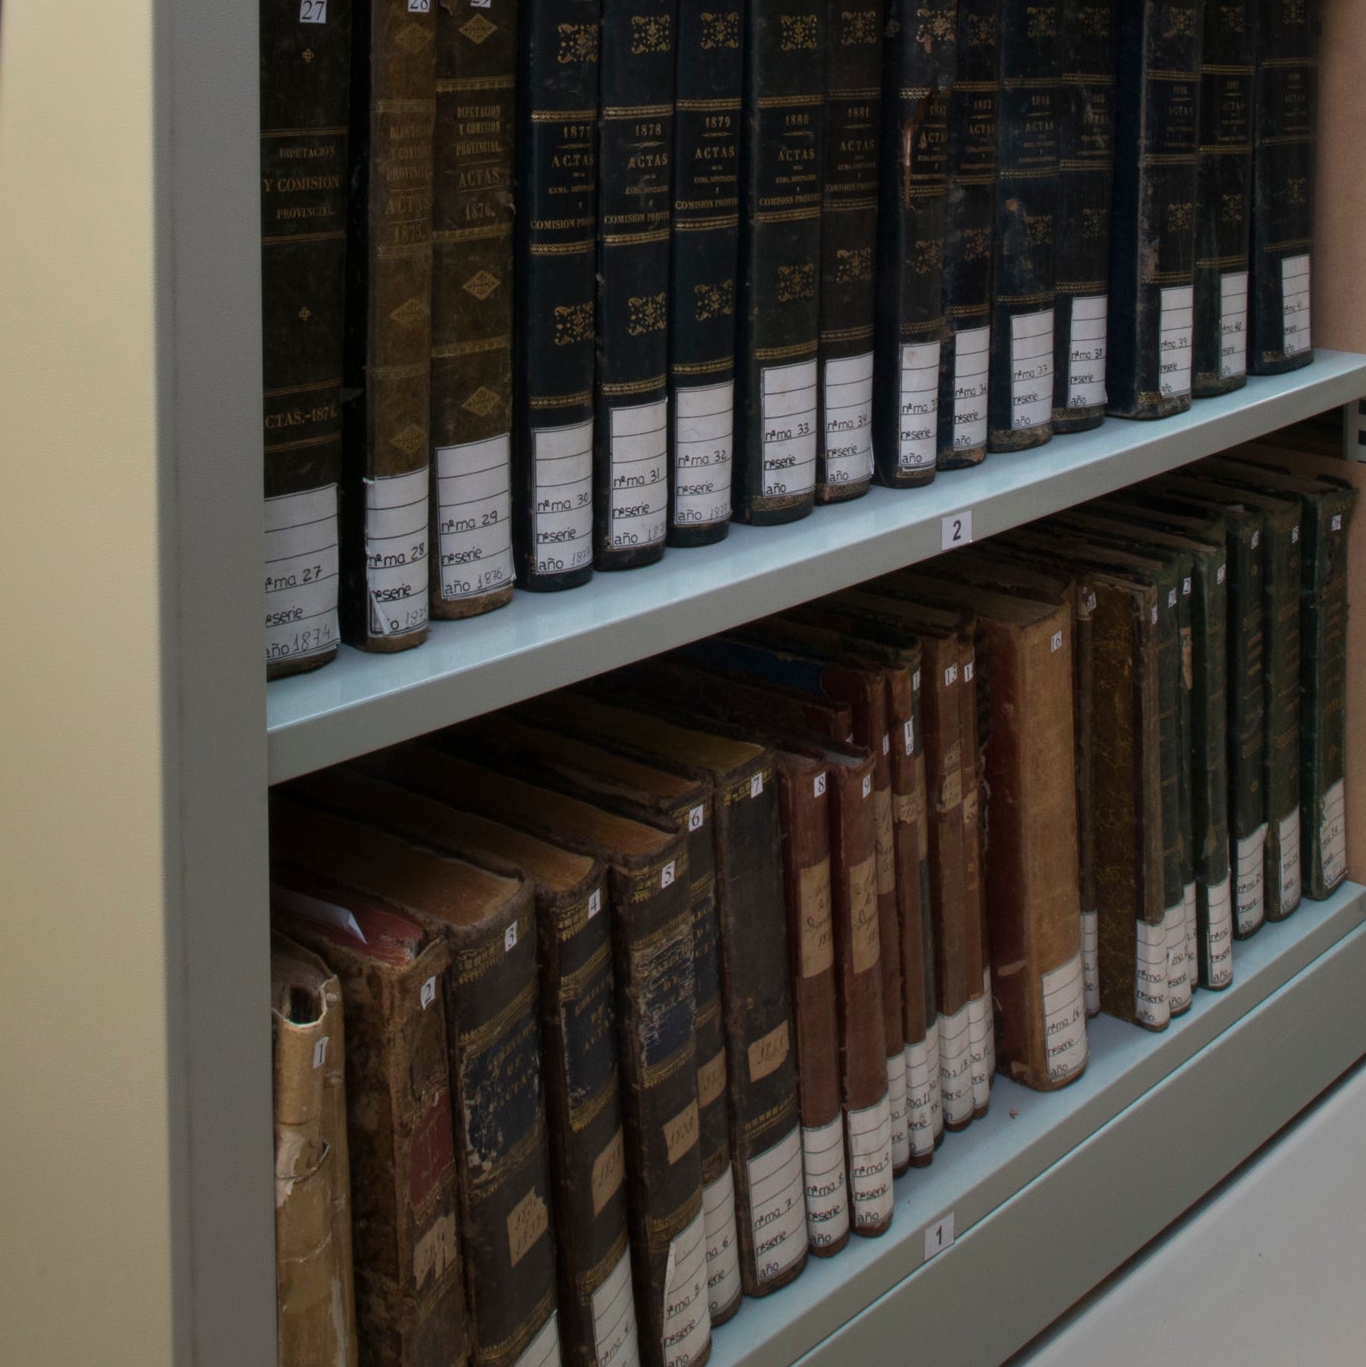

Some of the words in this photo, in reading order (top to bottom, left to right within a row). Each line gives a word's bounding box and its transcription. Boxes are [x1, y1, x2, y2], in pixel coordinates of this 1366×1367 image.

[301, 0, 325, 21] 27
[457, 105, 502, 119] DIPUTACION
[465, 120, 501, 134] COMISION
[705, 115, 731, 129] 1879
[635, 123, 662, 137] 1878
[279, 145, 335, 160] DIPUTACION
[694, 146, 735, 160] ACTAS
[839, 139, 875, 152] ACTAS
[551, 153, 595, 168] ACTAS
[627, 153, 668, 169] ACTAS
[778, 148, 816, 162] ACTAS
[263, 177, 274, 192] Y
[277, 174, 340, 193] COMISION
[458, 167, 501, 189] ACTAS
[675, 199, 714, 210] COMISION
[276, 205, 334, 220] PROVINCIAL
[604, 213, 644, 225] COMISION
[530, 219, 575, 231] COMISION
[797, 422, 810, 434] 33
[858, 415, 867, 427] 34
[714, 449, 728, 461] 32
[650, 467, 660, 482] 31
[577, 492, 589, 505] 30
[482, 510, 498, 526] 29
[953, 520, 962, 542] 2
[411, 542, 425, 561] 28
[303, 565, 322, 582] 27
[293, 624, 331, 653] 1874
[1051, 635, 1061, 651] 16
[751, 776, 763, 794] 7
[814, 775, 825, 794] 8
[690, 807, 701, 826] 6
[664, 865, 672, 884] 5
[590, 893, 598, 914] 4
[506, 925, 515, 948] 3
[424, 983, 434, 1004] 2
[317, 1044, 324, 1064] 1
[785, 1198, 793, 1211] 7
[937, 1226, 944, 1246] 1
